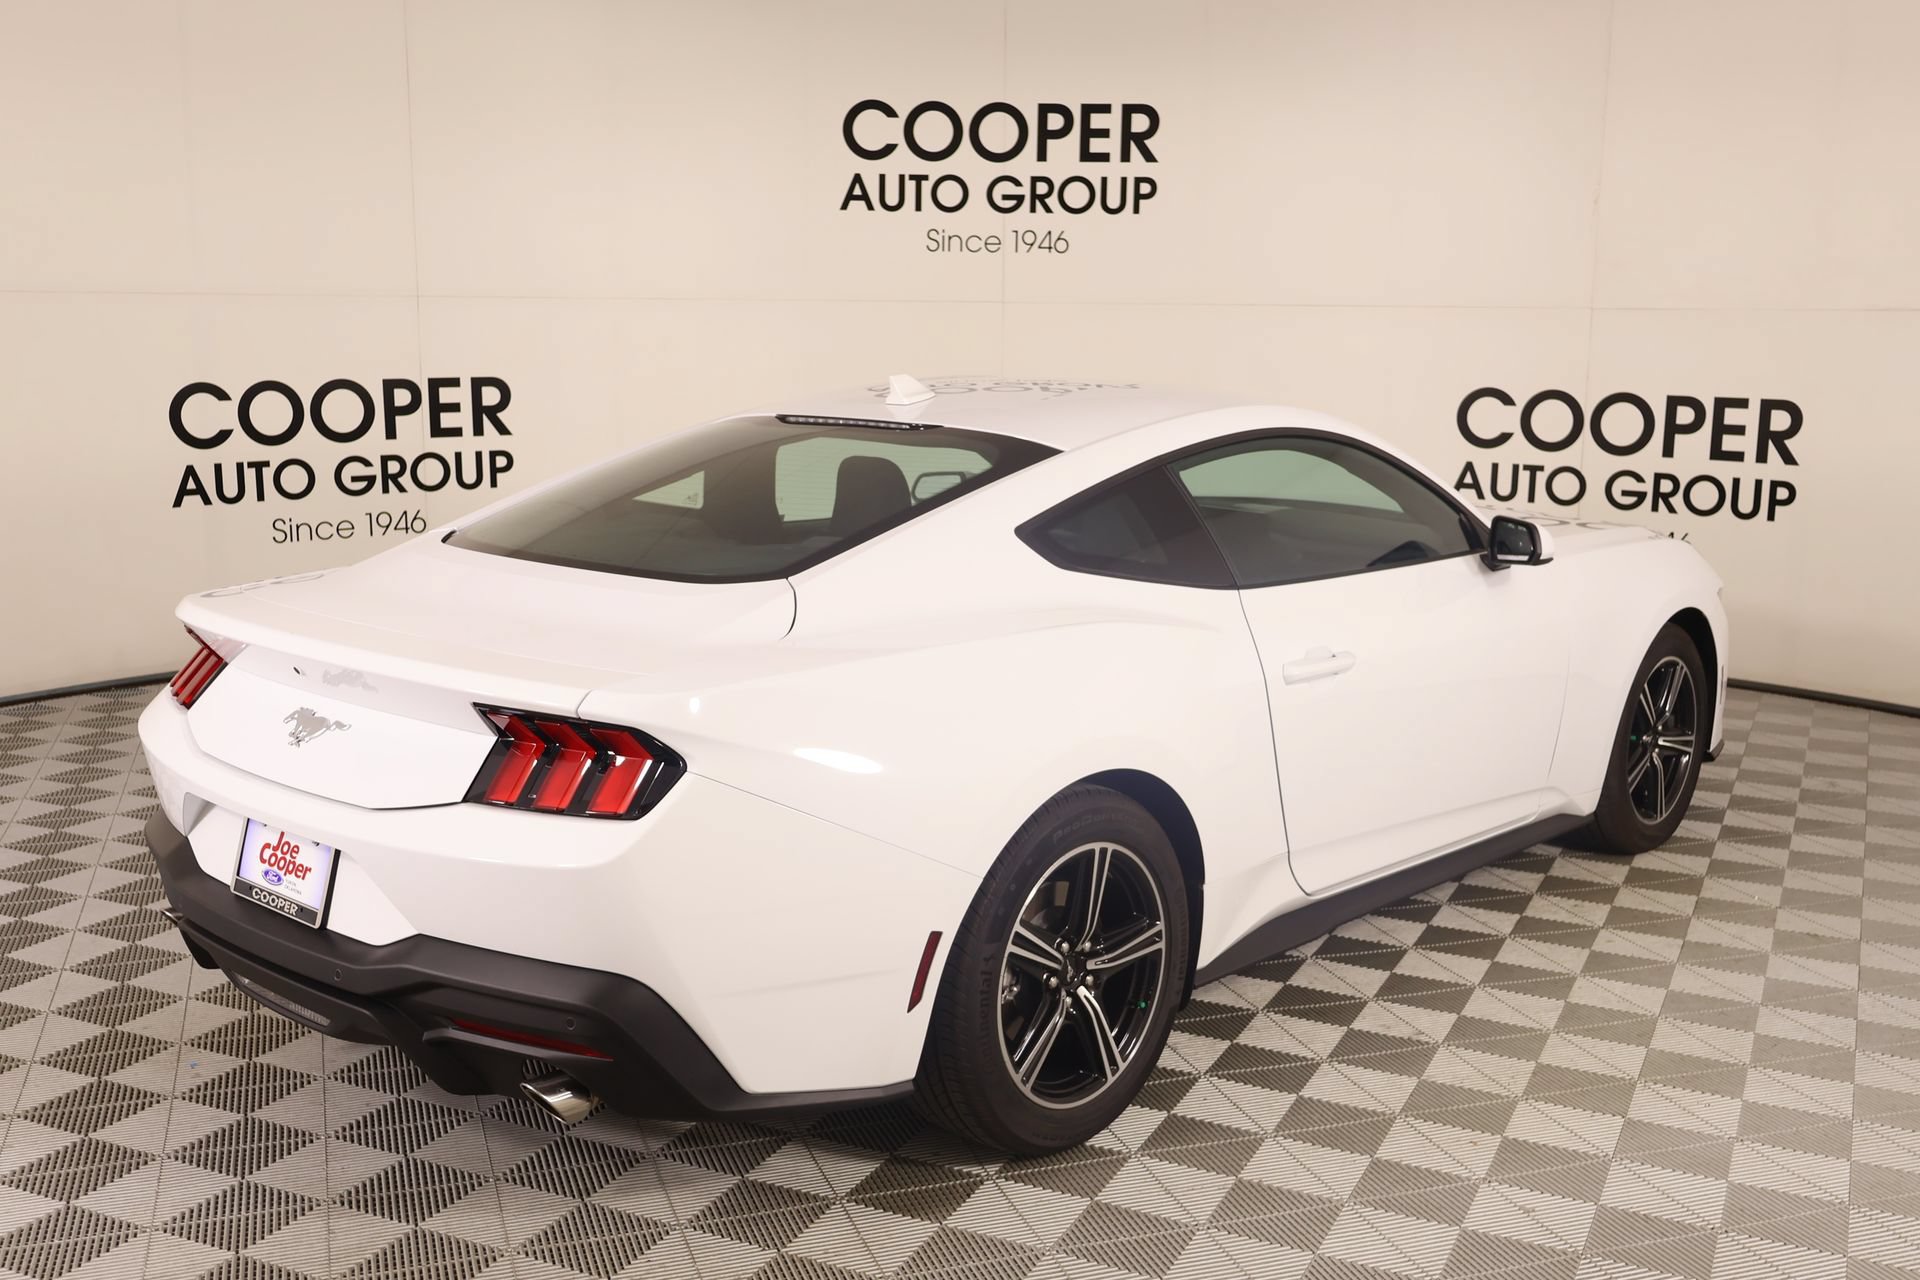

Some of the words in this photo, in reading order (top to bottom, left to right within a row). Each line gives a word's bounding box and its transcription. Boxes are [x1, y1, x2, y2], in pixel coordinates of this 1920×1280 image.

[843, 99, 1160, 163] COOPER
[840, 173, 969, 213] AUTO
[986, 174, 1157, 215] GROUP
[926, 229, 1002, 253] Since
[1012, 230, 1070, 254] 1946
[169, 377, 512, 450] COOPER
[1457, 387, 1803, 466] COOPER
[172, 458, 316, 508] AUTO
[334, 450, 514, 496] GROUP
[1454, 461, 1587, 506] AUTO
[1605, 470, 1796, 522] GROUP
[272, 518, 356, 544] Since
[365, 509, 427, 537] 1946
[259, 842, 312, 880] Cooper
[272, 831, 300, 860] Joe
[252, 888, 299, 916] COOPER
